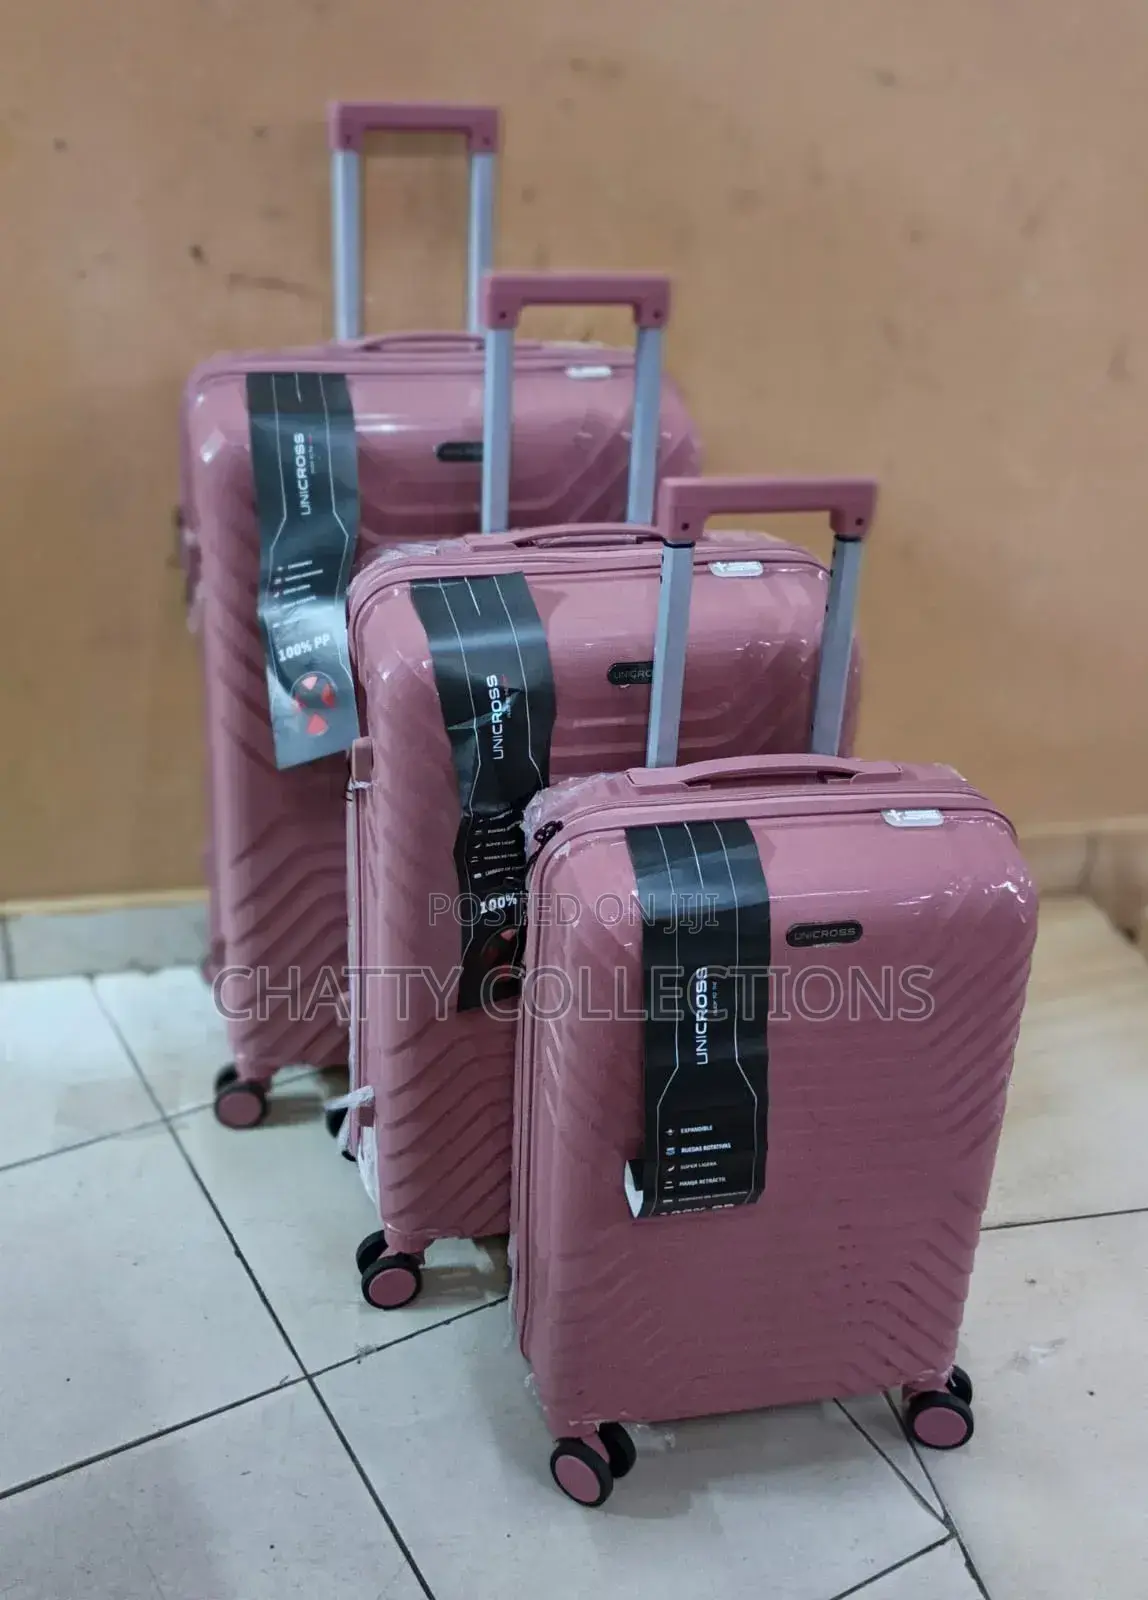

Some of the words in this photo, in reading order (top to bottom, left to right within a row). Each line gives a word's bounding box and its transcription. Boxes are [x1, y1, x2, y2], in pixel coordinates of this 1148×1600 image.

[293, 432, 312, 516] UNICROSS
[278, 639, 314, 662] 100%
[314, 633, 331, 649] PP
[486, 674, 504, 760] UNICROSS
[480, 892, 518, 914] 100%
[794, 927, 857, 941] UNICROSS
[695, 966, 709, 1065] UNICROSS
